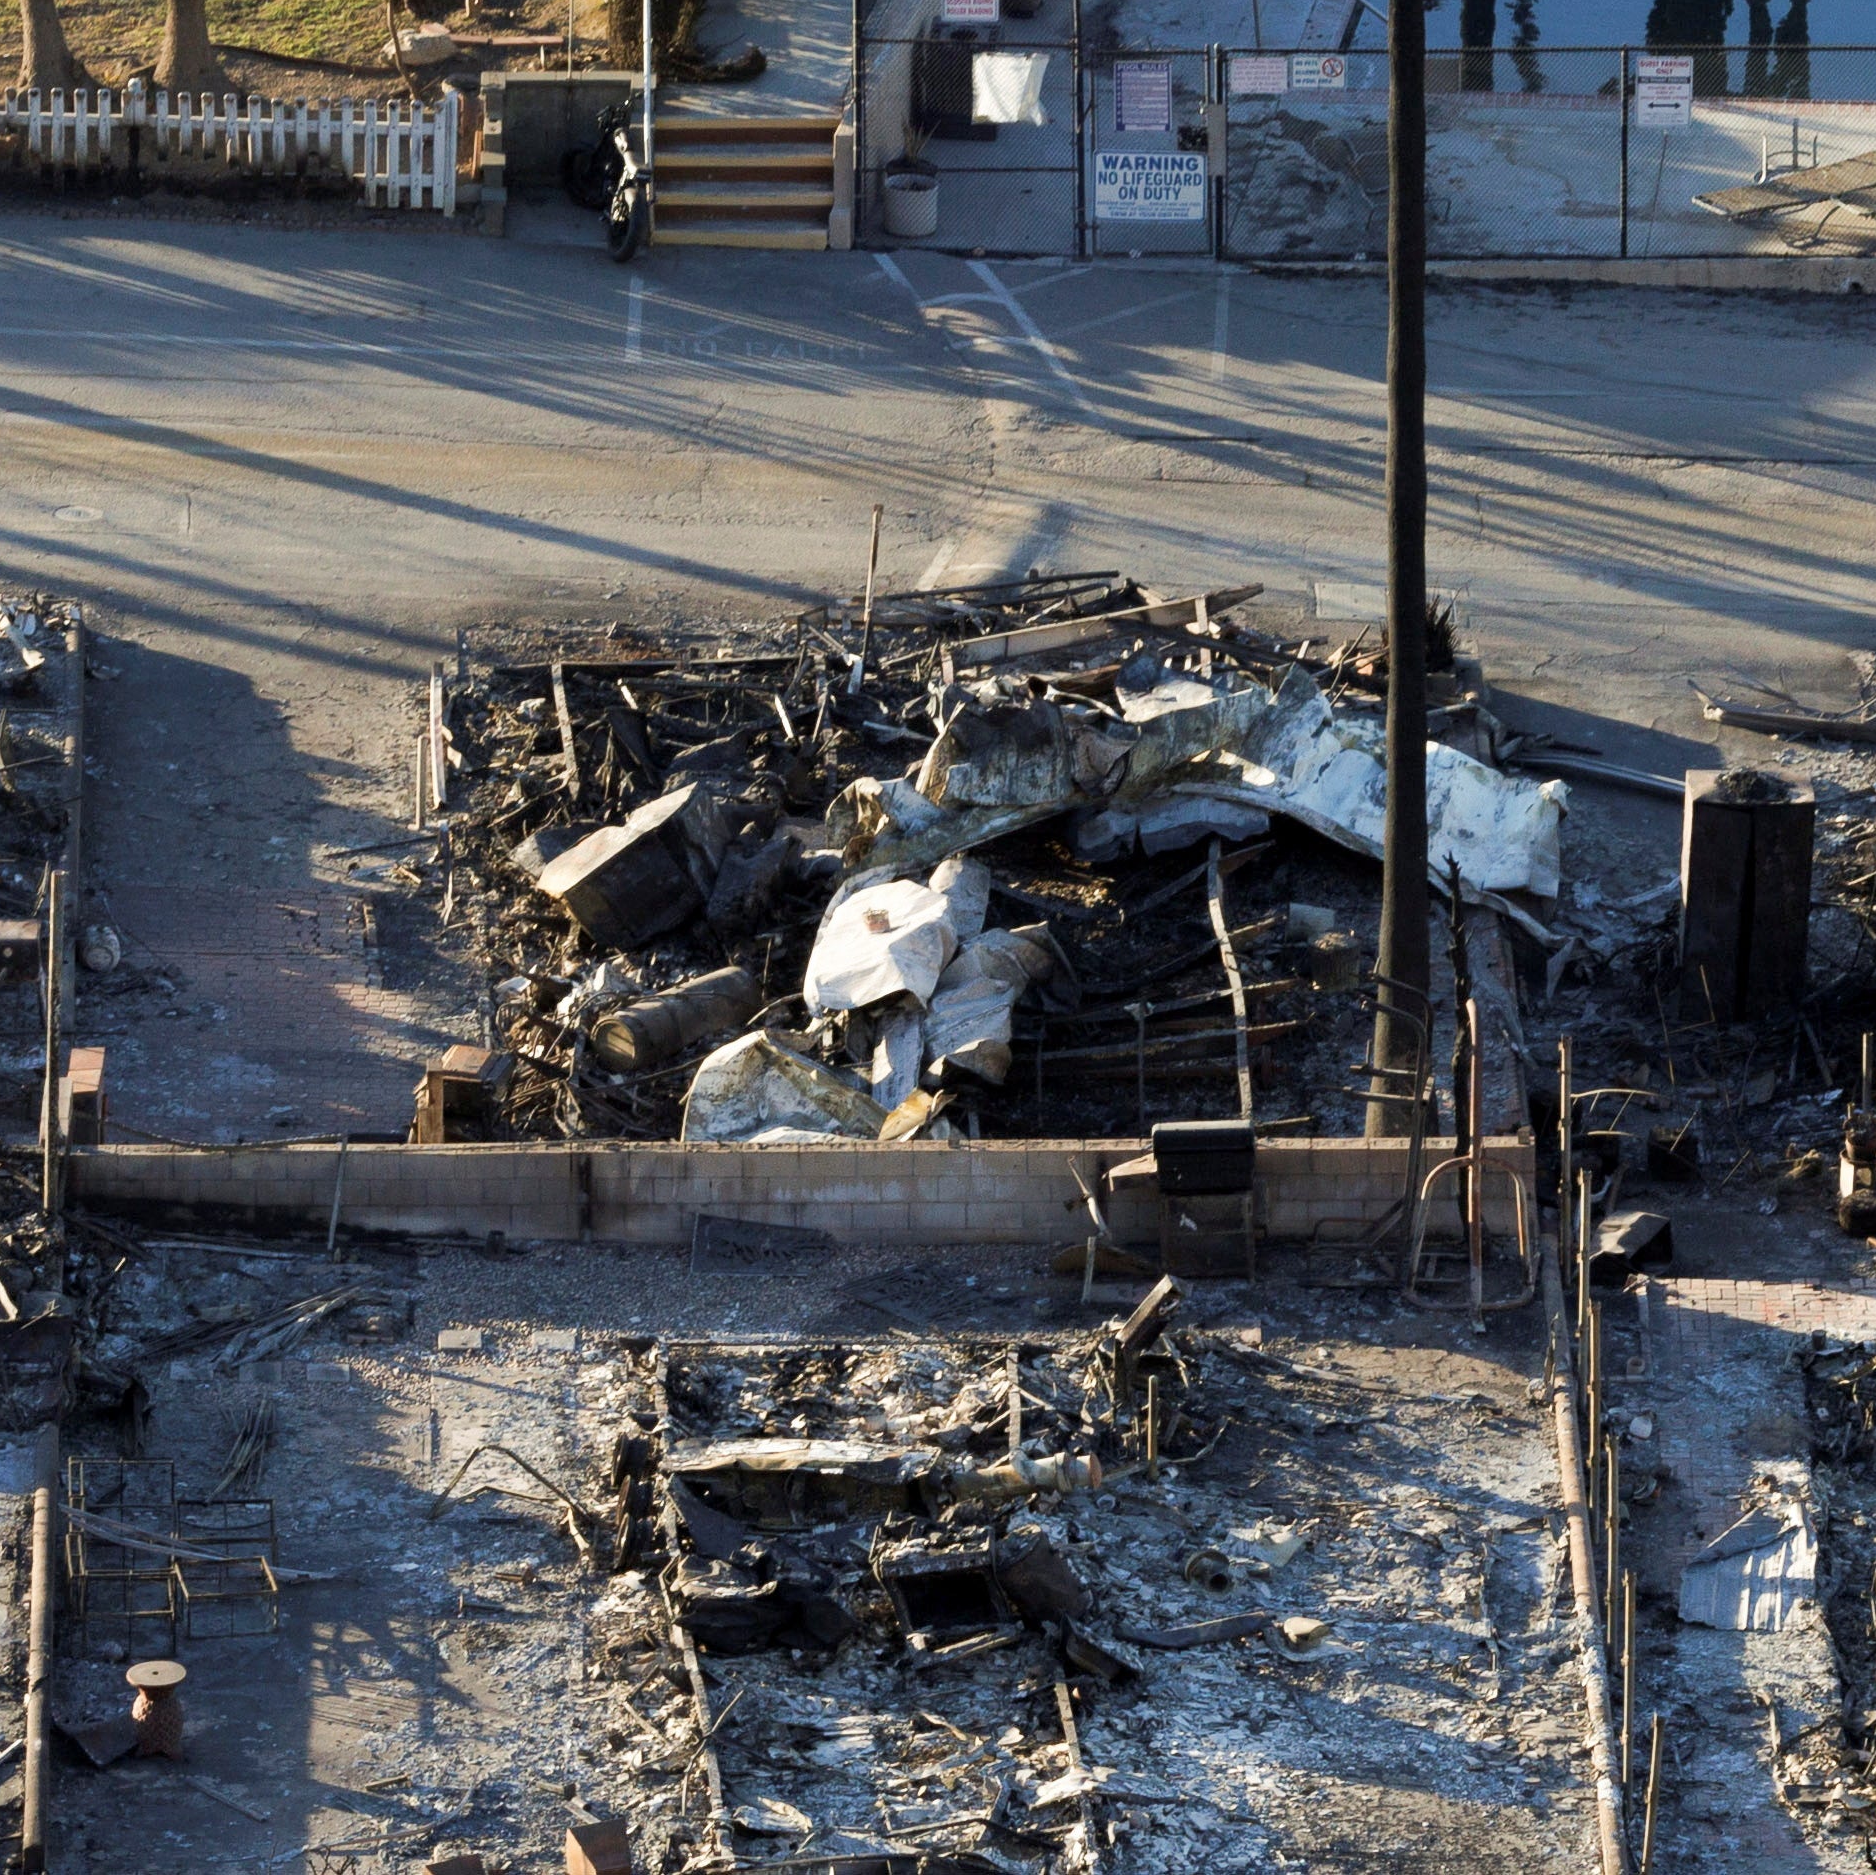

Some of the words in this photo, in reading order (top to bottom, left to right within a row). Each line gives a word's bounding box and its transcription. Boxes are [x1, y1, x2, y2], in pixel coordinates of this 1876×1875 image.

[1101, 155, 1199, 172] WARNING
[1098, 171, 1119, 185] NO
[1122, 171, 1203, 187] LIFEGUARD
[1118, 185, 1139, 200] ON
[1143, 186, 1182, 201] DUTY
[662, 337, 718, 357] NO
